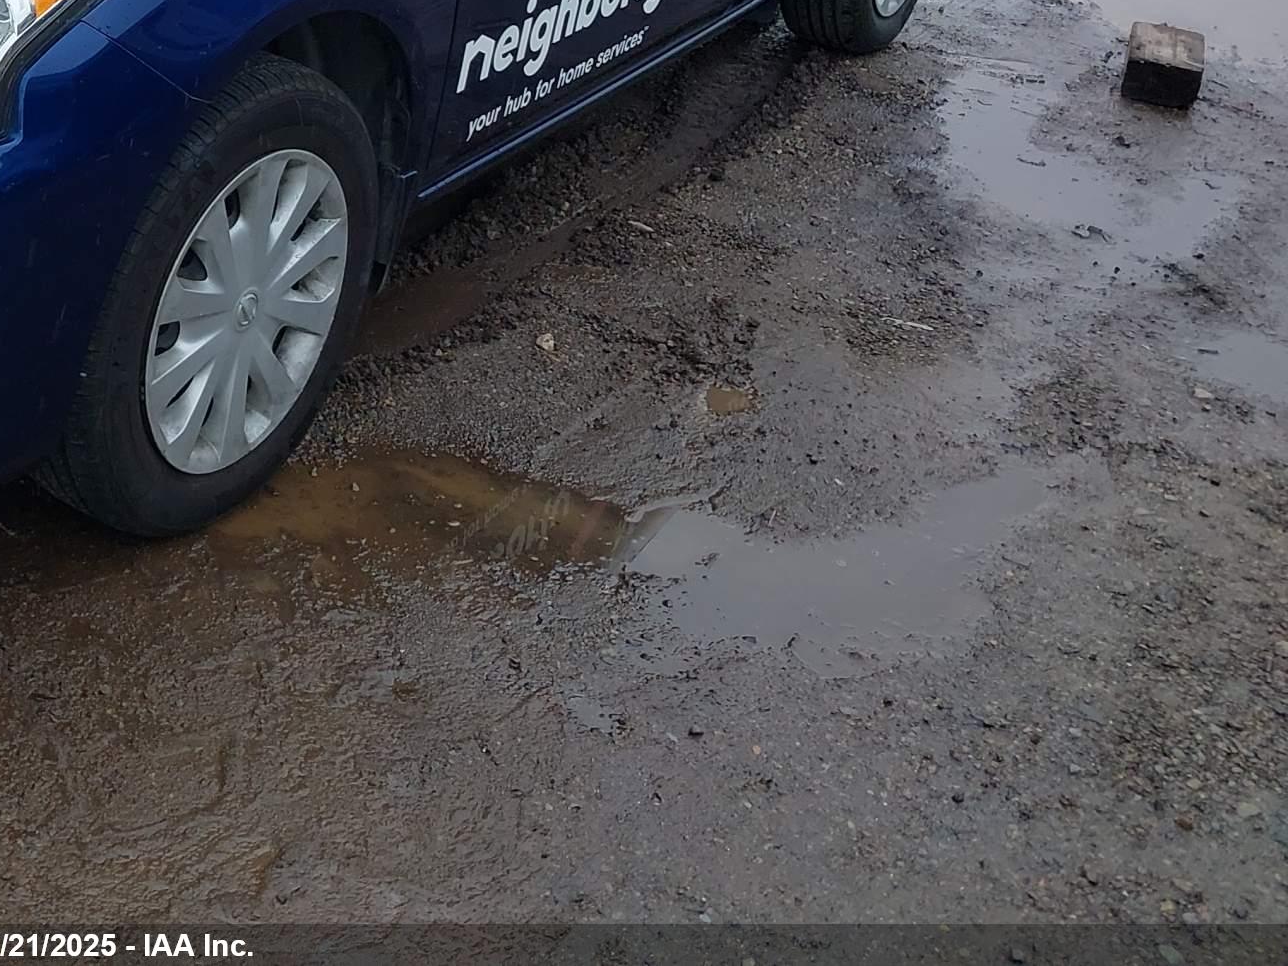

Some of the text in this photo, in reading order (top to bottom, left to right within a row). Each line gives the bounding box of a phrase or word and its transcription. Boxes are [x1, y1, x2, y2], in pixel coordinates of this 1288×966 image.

[466, 31, 645, 142] your hub for home services
